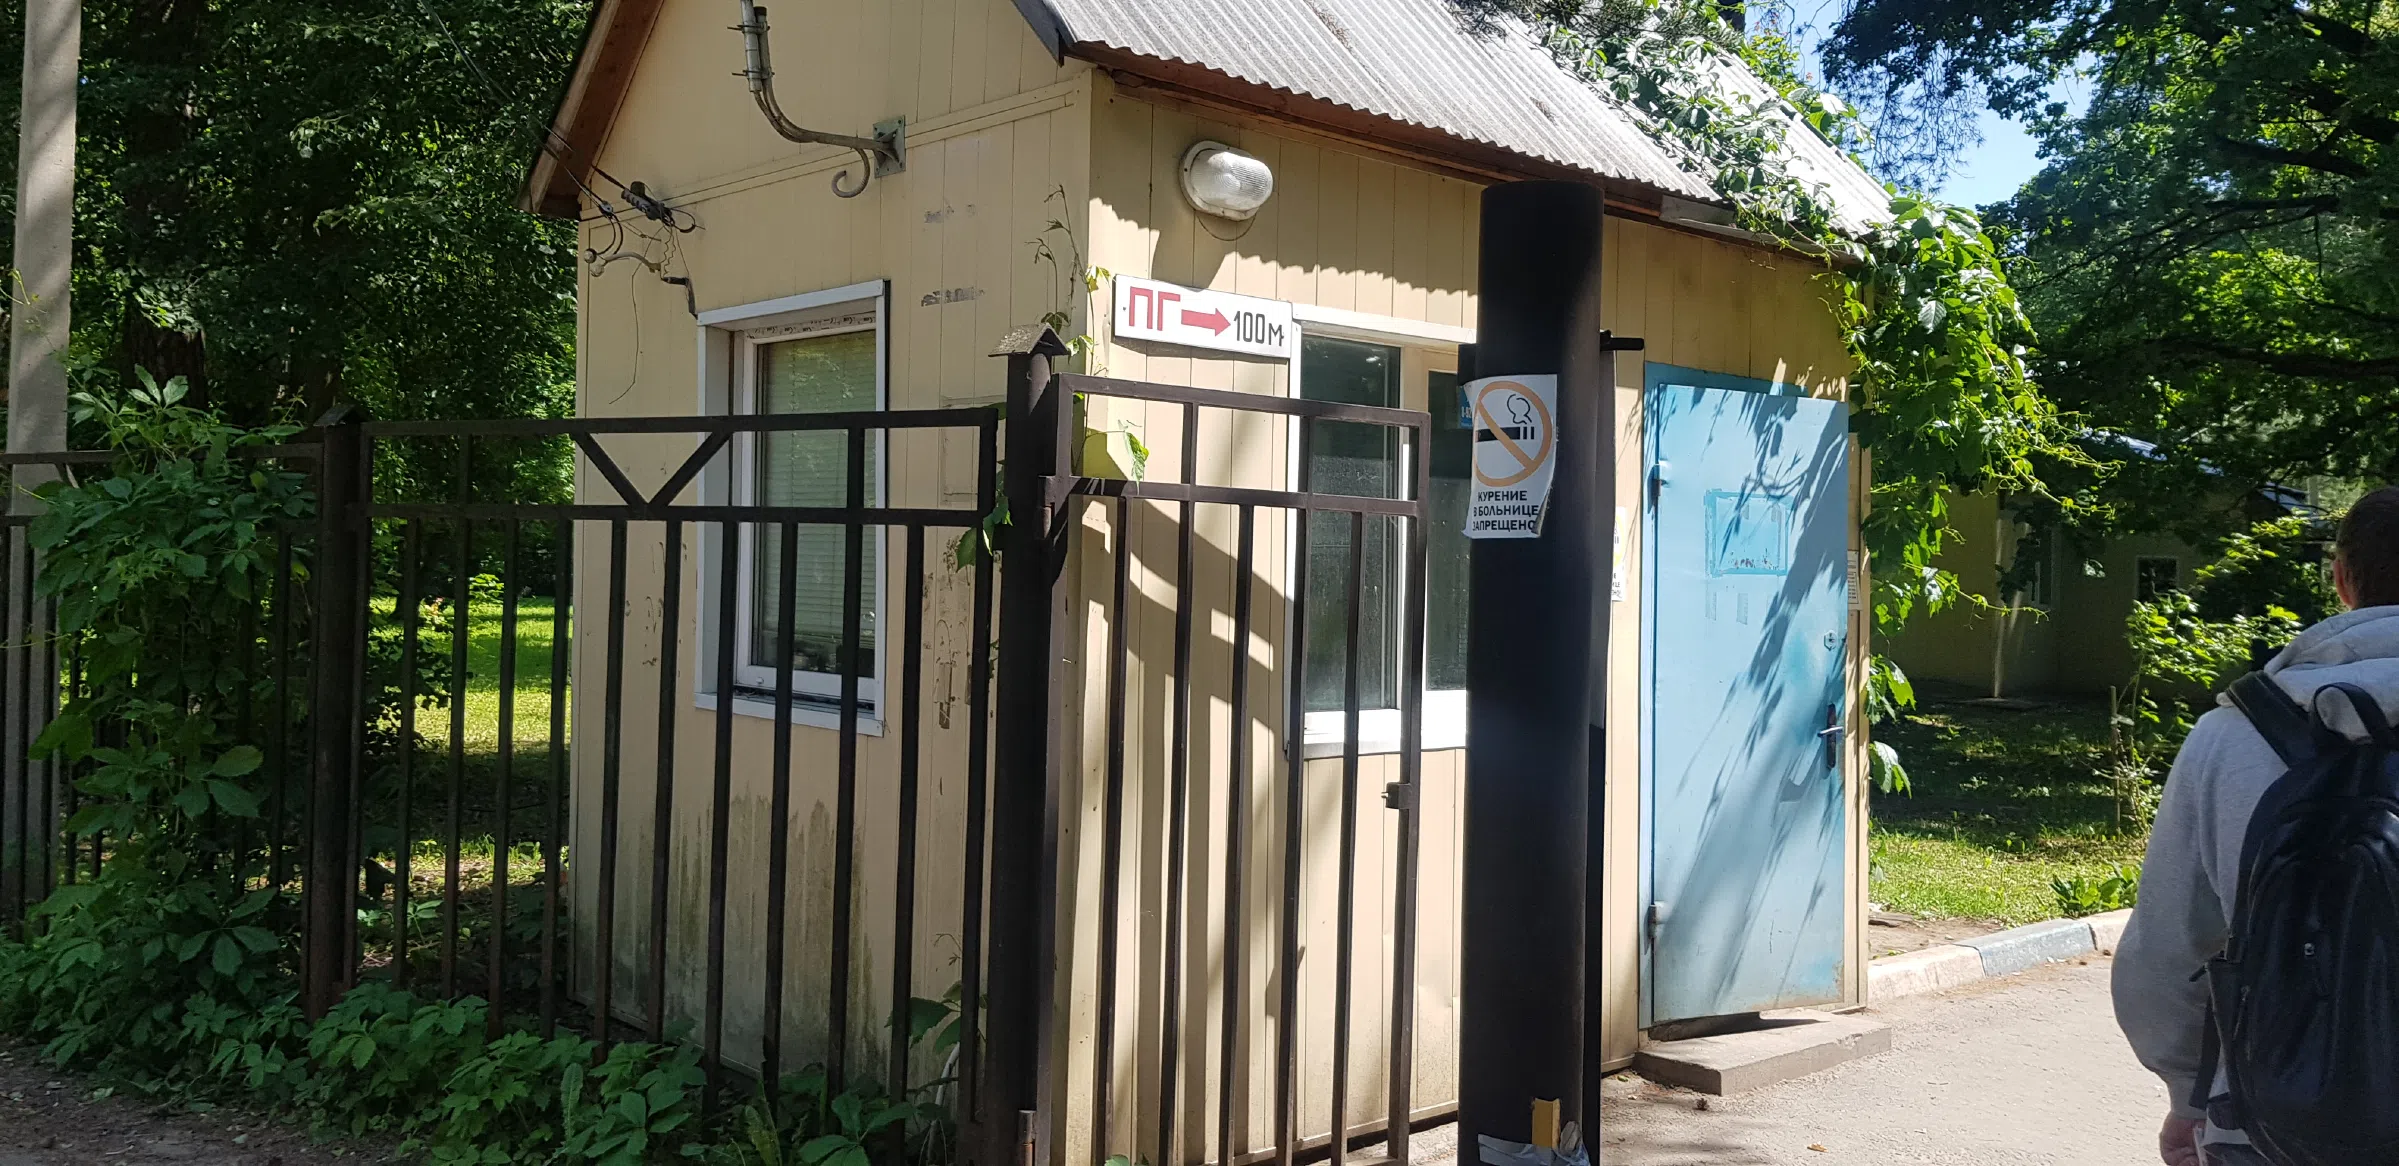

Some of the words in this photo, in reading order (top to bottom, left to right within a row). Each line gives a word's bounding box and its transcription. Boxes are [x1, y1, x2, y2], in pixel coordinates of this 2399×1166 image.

[1128, 286, 1181, 331] ПГ
[1477, 490, 1528, 502] КУРЕНИЕ
[1478, 505, 1539, 517] БОЛЬНИЦЕ
